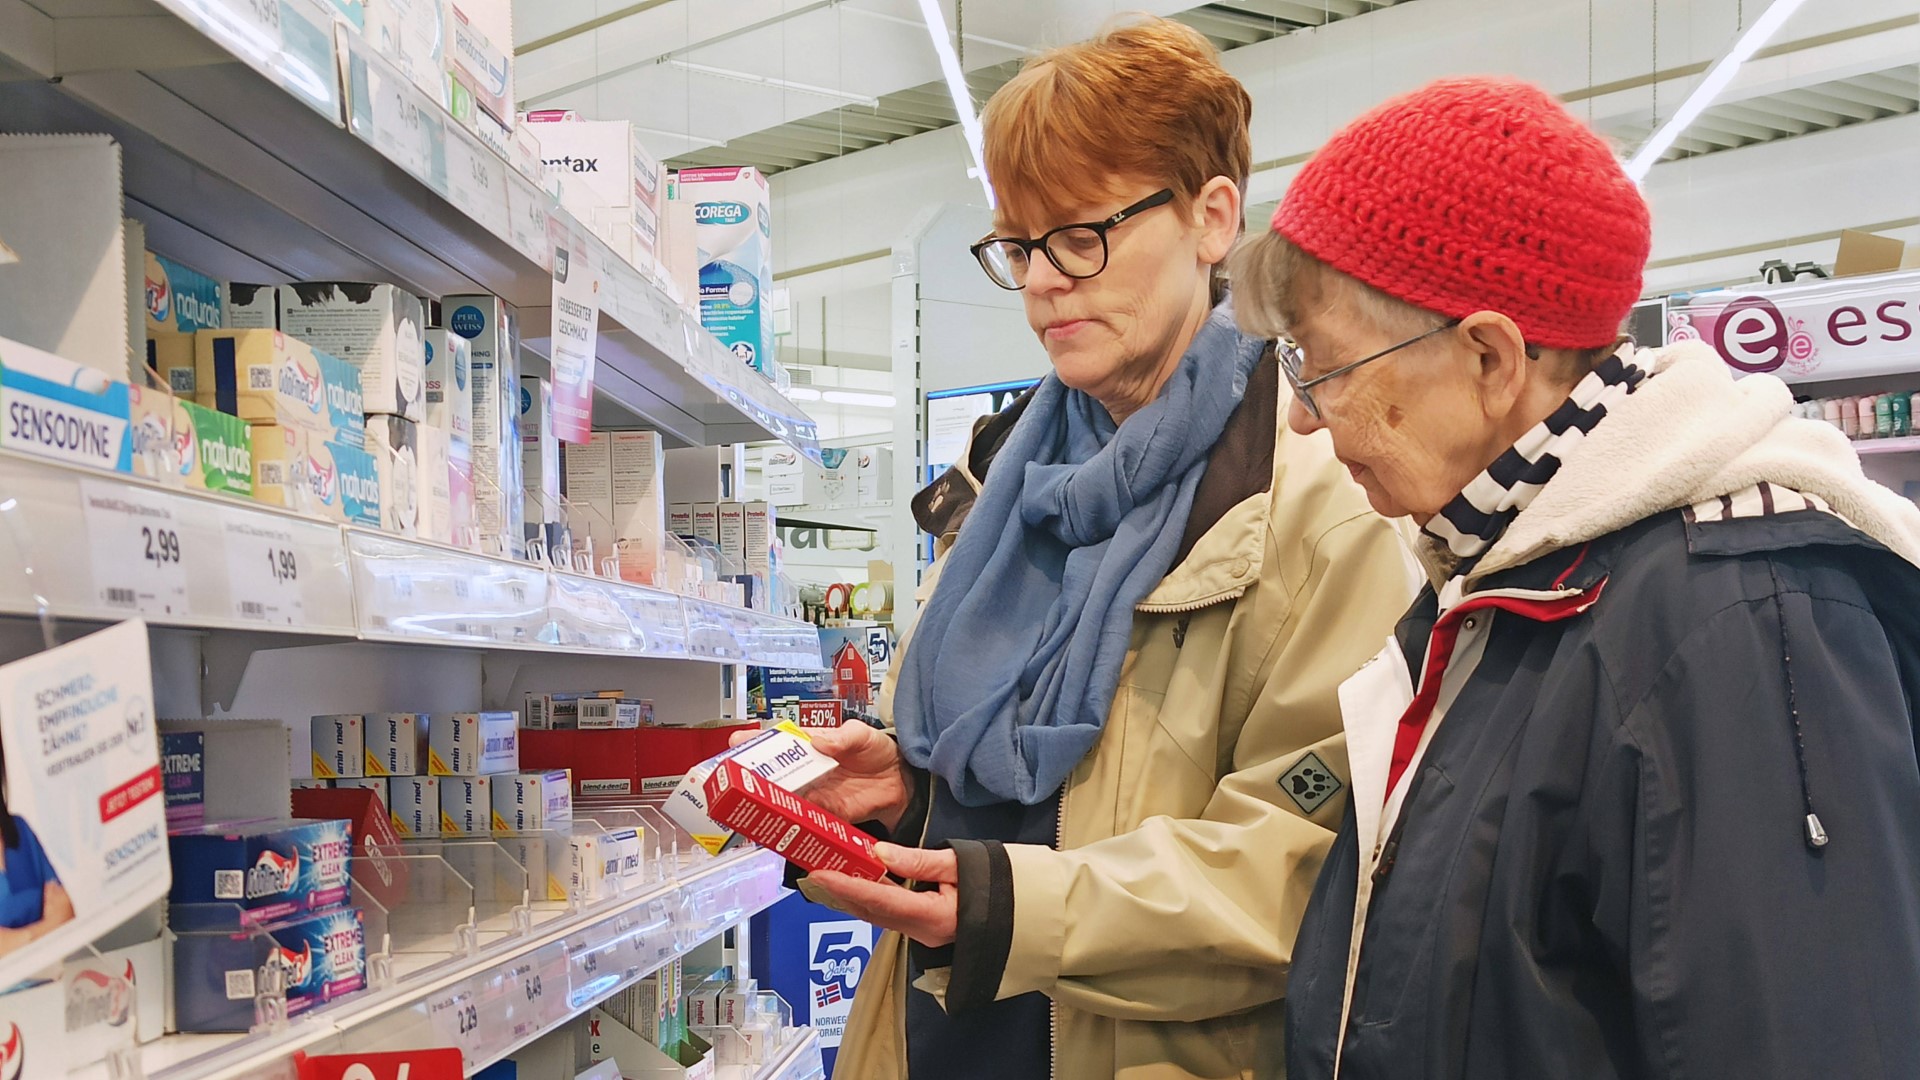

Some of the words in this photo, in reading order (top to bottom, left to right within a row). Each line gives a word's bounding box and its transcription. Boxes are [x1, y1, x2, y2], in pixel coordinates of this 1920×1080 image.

[695, 204, 742, 219] COREGA
[706, 286, 728, 294] Formel
[176, 292, 220, 329] naturals
[457, 313, 478, 321] PERL
[558, 296, 592, 322] VERBESSERTER
[454, 323, 482, 331] WEISS
[559, 318, 588, 342] GESCHMACK
[1827, 299, 1920, 346] es
[1722, 307, 1780, 365] e
[328, 380, 363, 417] naturals
[10, 402, 110, 459] SENSODYNE
[202, 436, 251, 477] naturals
[341, 469, 379, 504] naturals
[142, 526, 180, 569] 2,99
[268, 548, 297, 584] 1,99
[810, 709, 836, 726] 50%
[335, 719, 343, 745] med
[388, 718, 397, 743] med
[164, 753, 201, 774] XTREME
[751, 740, 808, 778] inomed
[413, 782, 421, 805] med
[464, 782, 472, 805] med
[515, 782, 523, 805] med
[582, 782, 623, 791] blend-a-dent
[644, 779, 681, 790] blend-a-den
[680, 789, 703, 810] med
[312, 840, 350, 862] EXTREME
[625, 848, 639, 869] med
[321, 862, 340, 876] CLEAN
[324, 928, 362, 954] EXTREME
[335, 952, 354, 966] CLEAN
[809, 931, 872, 1000] 50
[824, 958, 856, 981] Jahre
[526, 974, 542, 1003] 6,49
[458, 1004, 478, 1037] 2,29
[697, 1000, 705, 1025] Protefix
[726, 999, 735, 1024] Protefix
[815, 1015, 848, 1027] NORWEG
[819, 1027, 843, 1038] ORMEL
